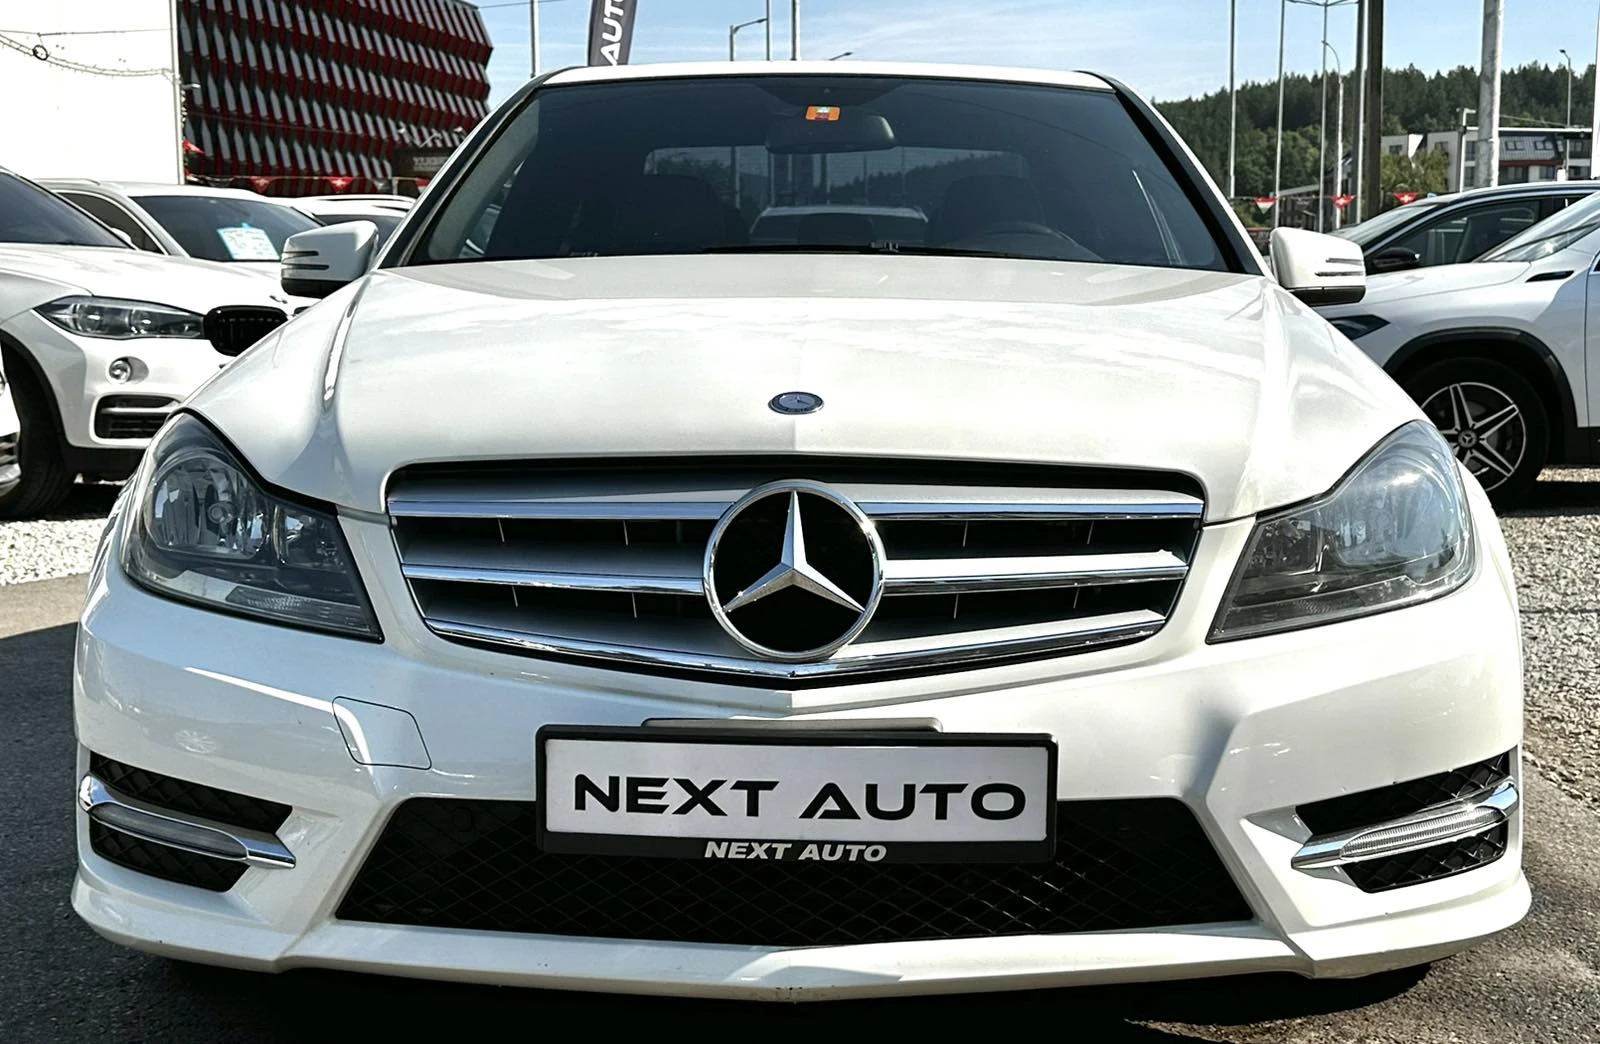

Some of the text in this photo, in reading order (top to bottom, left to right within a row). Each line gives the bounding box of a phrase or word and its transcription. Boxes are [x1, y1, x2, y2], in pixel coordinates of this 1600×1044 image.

[600, 0, 624, 66] AUT
[574, 773, 1026, 821] NEXT AUTO
[704, 841, 887, 862] NEXT AUTO
